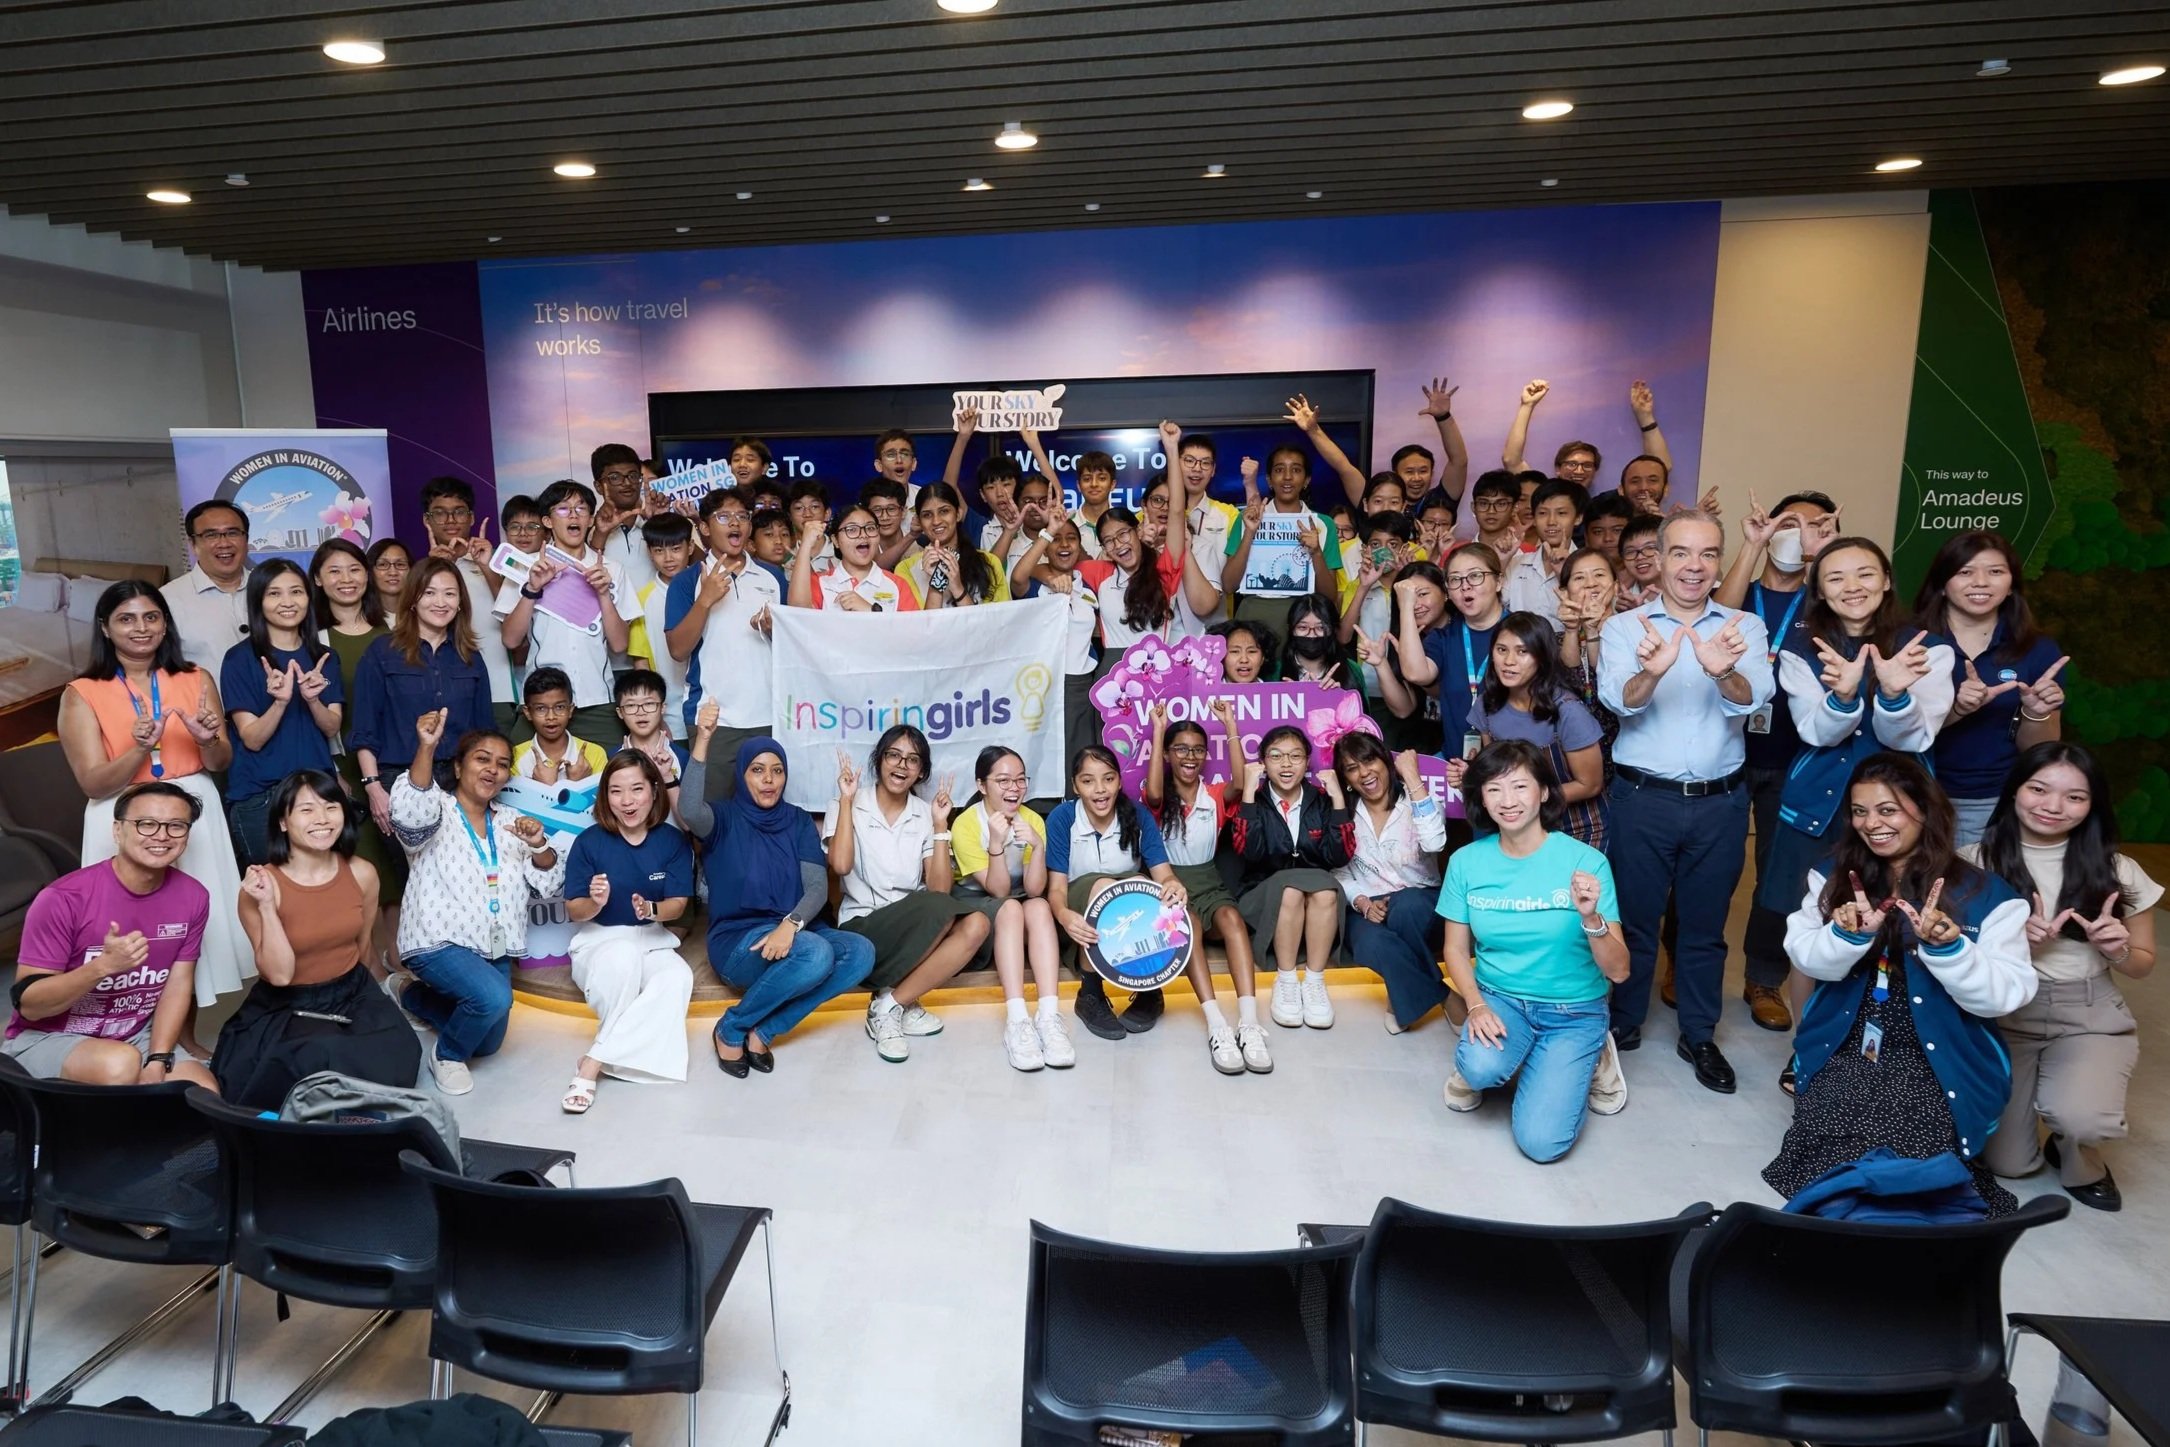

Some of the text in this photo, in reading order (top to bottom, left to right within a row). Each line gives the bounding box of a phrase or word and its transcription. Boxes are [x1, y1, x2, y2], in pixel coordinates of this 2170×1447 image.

[323, 306, 417, 332] Airlines
[575, 301, 620, 322] how
[627, 298, 688, 320] travel
[536, 335, 601, 357] works
[957, 394, 1038, 410] YOUR SKY
[956, 411, 1059, 428] UR STORY
[229, 453, 344, 485] WOMEN IN AVIATION
[783, 456, 815, 477] To
[1133, 448, 1167, 470] To
[651, 468, 708, 492] WOMEN
[710, 462, 727, 477] IN
[1926, 469, 1989, 481] This way to
[668, 475, 735, 503] ATION SG
[1922, 489, 2023, 506] Amadeus
[1920, 513, 2000, 531] Lounge
[1276, 532, 1302, 541] STOR
[1271, 692, 1305, 720] IN
[1090, 882, 1161, 919] WOMEN IN AVIATION
[95, 965, 171, 991] eache
[1118, 958, 1182, 986] SINGAPORE CHAPTER
[112, 993, 142, 1009] 100%
